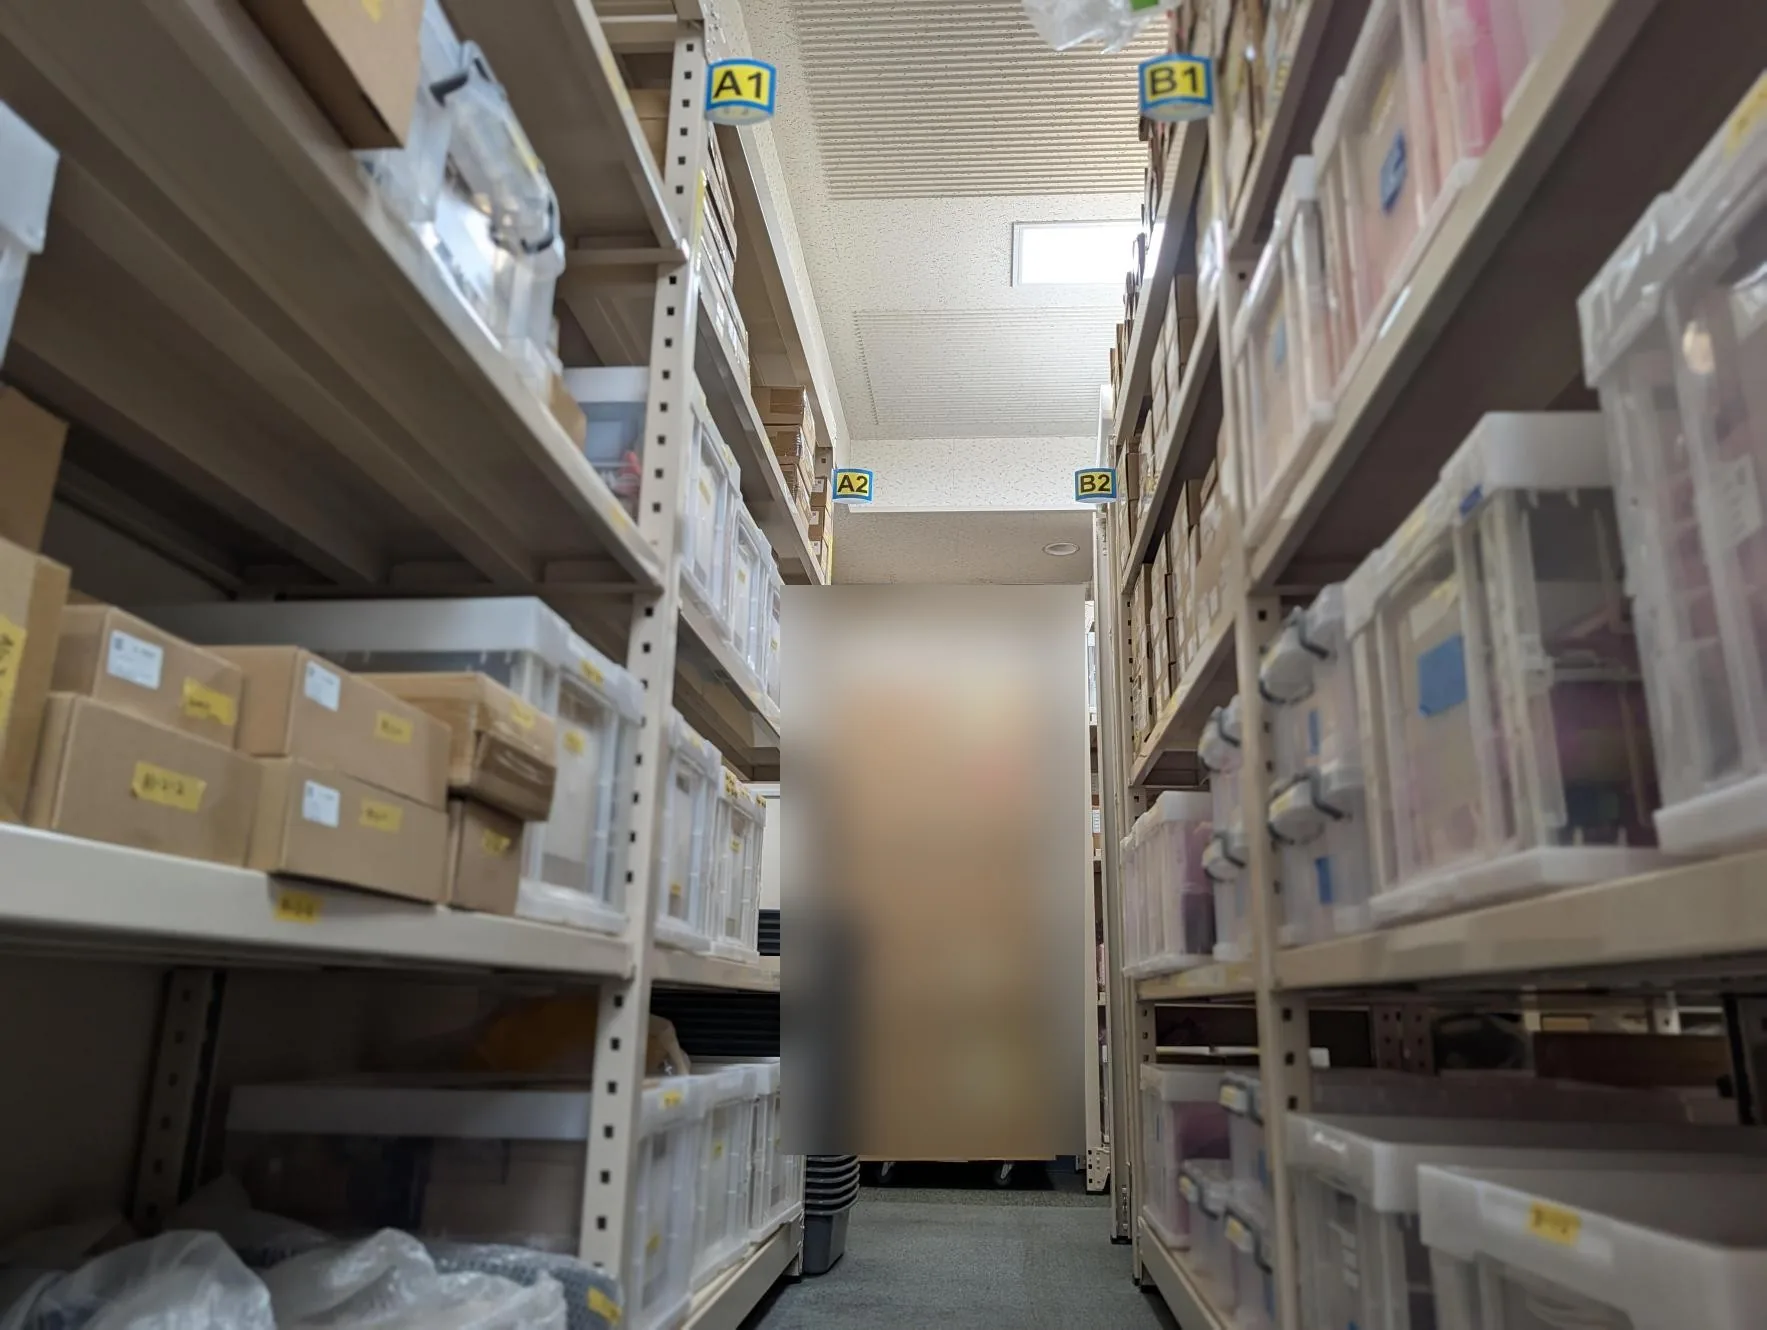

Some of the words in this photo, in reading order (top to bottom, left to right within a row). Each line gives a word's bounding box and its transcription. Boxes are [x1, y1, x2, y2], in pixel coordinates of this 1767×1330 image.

[713, 70, 762, 99] A1
[1150, 66, 1197, 95] B1
[837, 474, 868, 494] A2
[1080, 474, 1111, 494] B2
